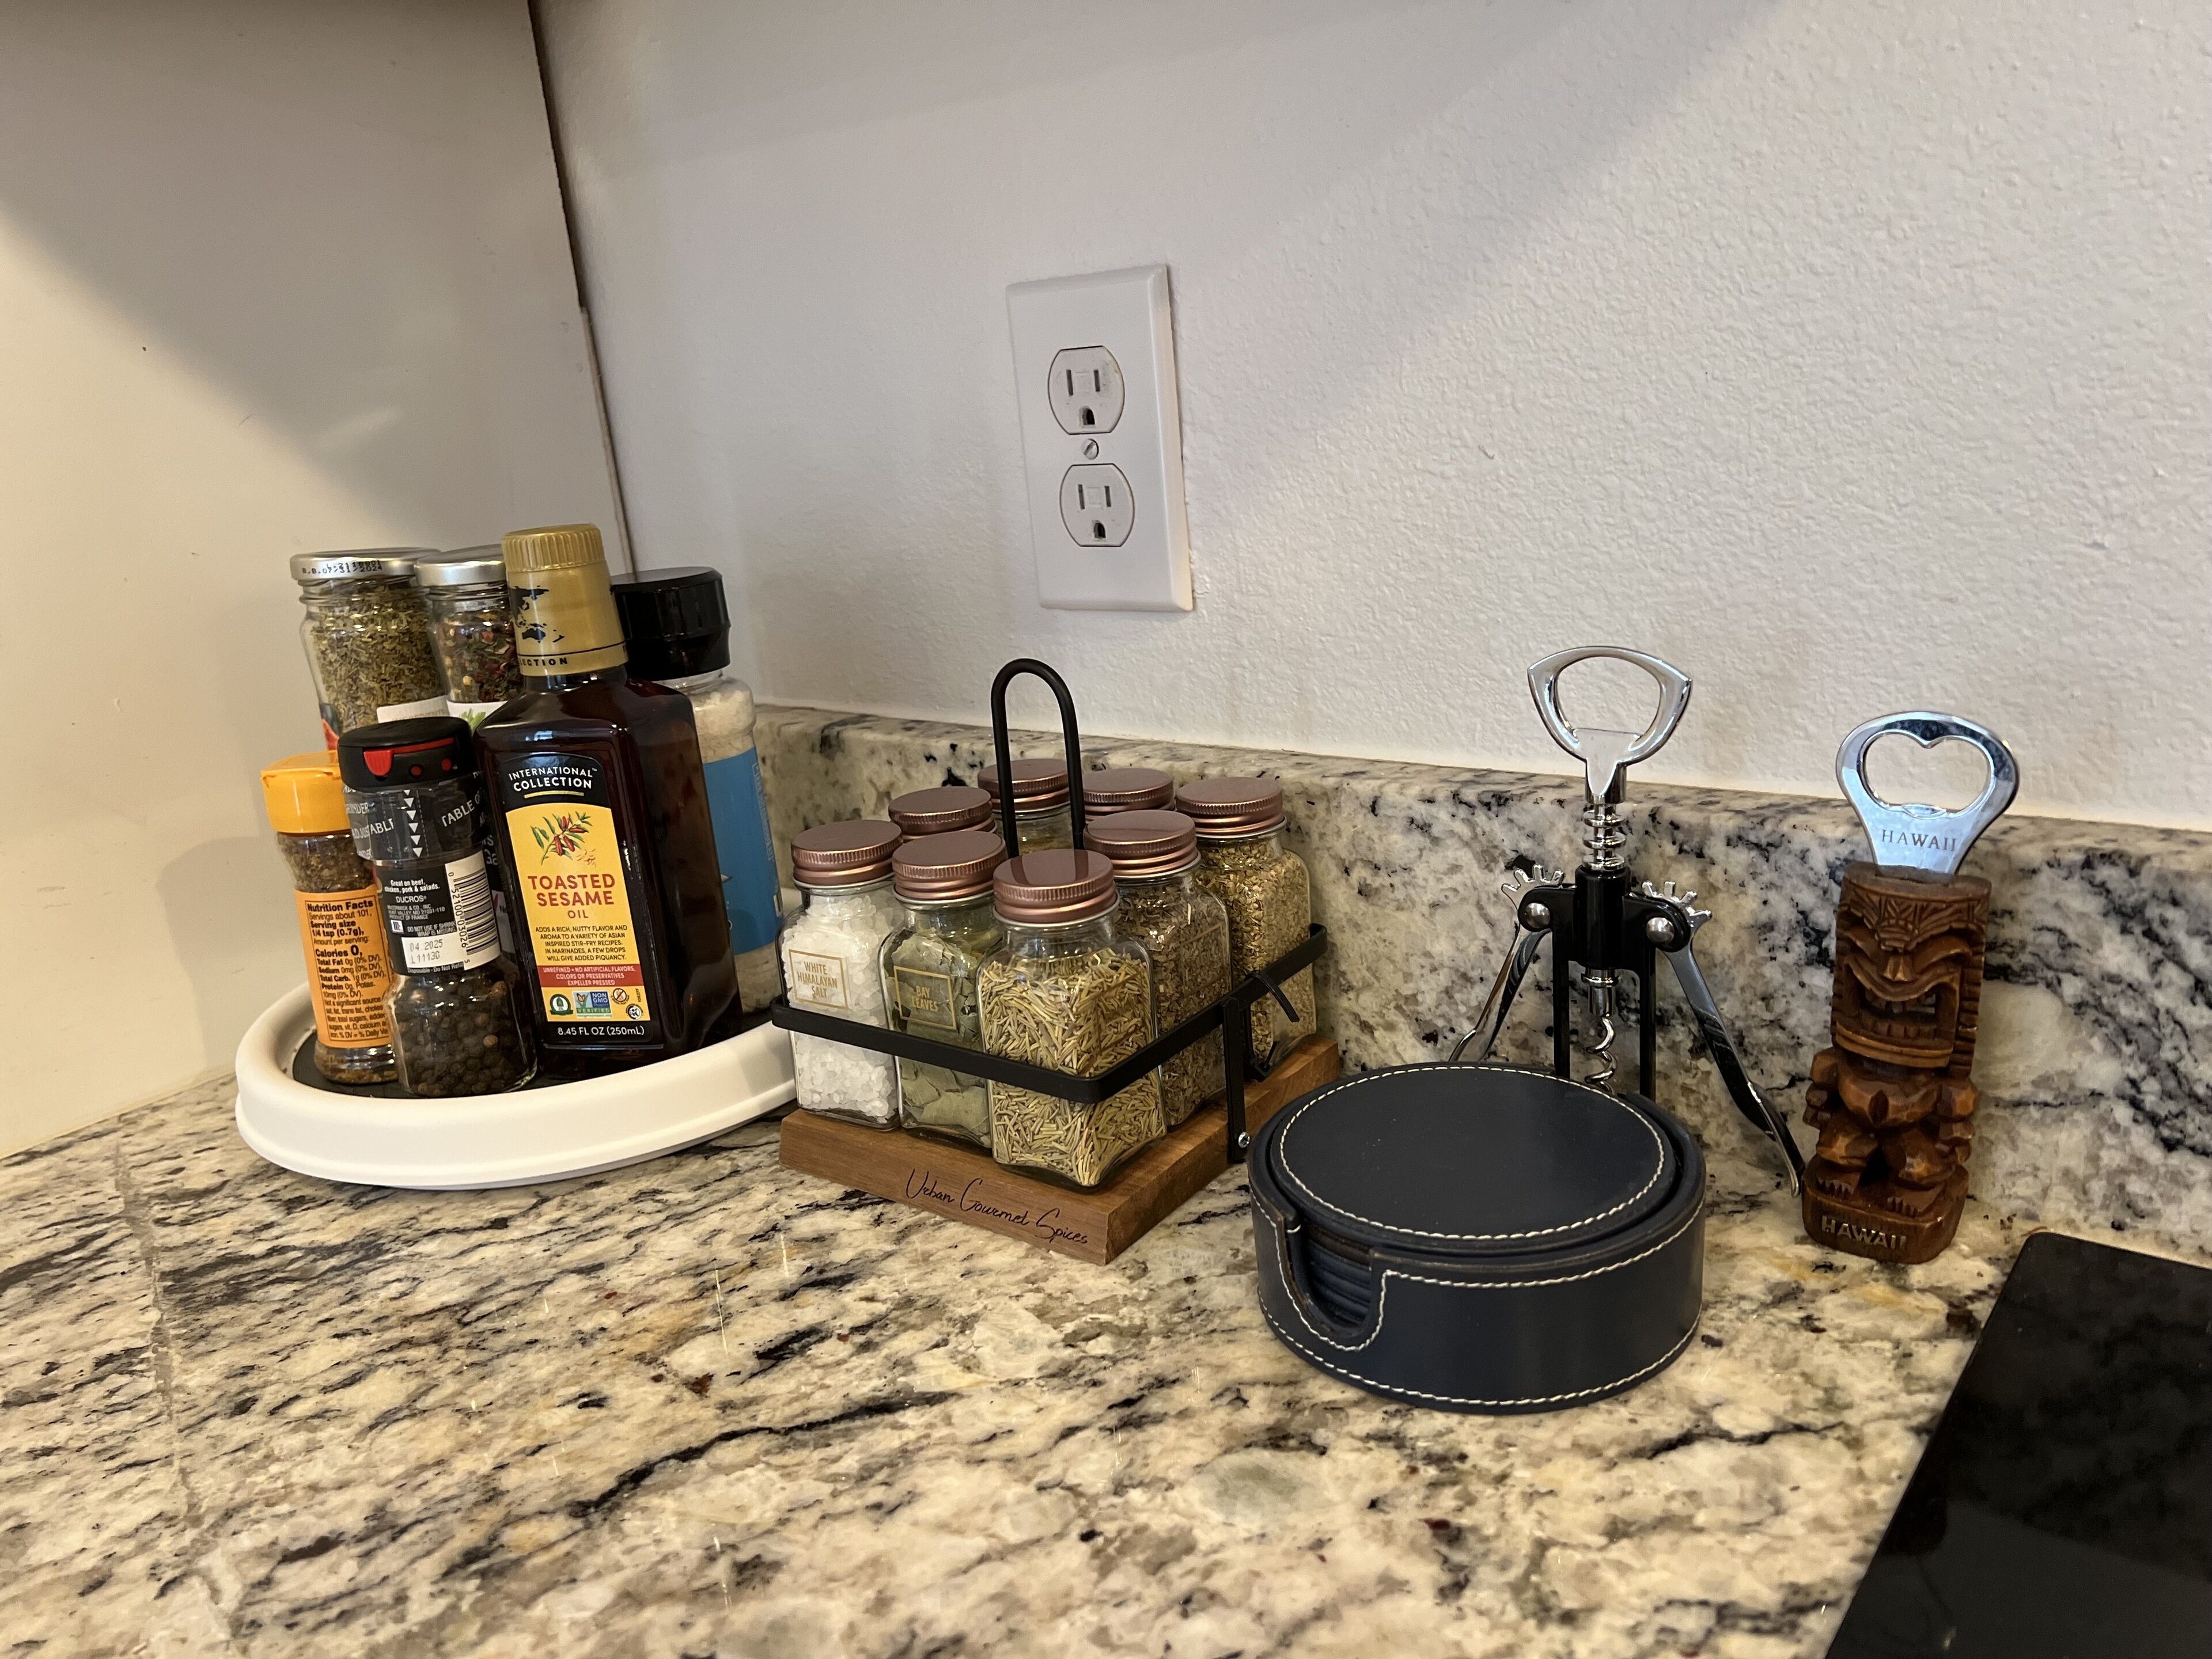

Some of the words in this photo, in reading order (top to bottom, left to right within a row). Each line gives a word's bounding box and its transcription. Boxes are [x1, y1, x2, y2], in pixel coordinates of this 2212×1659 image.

[514, 777, 592, 791] COLLECTION
[1881, 829, 1957, 851] HAWAII
[528, 874, 615, 890] TOASTED
[307, 903, 343, 911] Nutrition
[346, 900, 373, 910] Facts
[452, 888, 463, 916] 52100
[537, 891, 614, 906] SESAME
[309, 912, 334, 921] Servings
[335, 911, 355, 919] about
[568, 910, 589, 919] OIL
[310, 921, 336, 929] Serving
[323, 927, 334, 937] tsp
[457, 920, 468, 948] 03026
[316, 949, 349, 957] Calories
[804, 961, 827, 975] WHITE
[797, 972, 838, 988] HIMALAYAN
[812, 984, 827, 998] SALT
[916, 985, 930, 998] BAY
[912, 995, 938, 1012] LEAVES
[558, 1027, 577, 1035] 8.45
[579, 1027, 589, 1035] FL
[591, 1027, 605, 1035] OZ
[607, 1025, 645, 1036] (250mL)
[906, 1168, 955, 1203] Urban
[960, 1178, 1029, 1225] Gourmet
[1036, 1208, 1088, 1244] Spices
[1822, 1215, 1907, 1249] HAWAII
